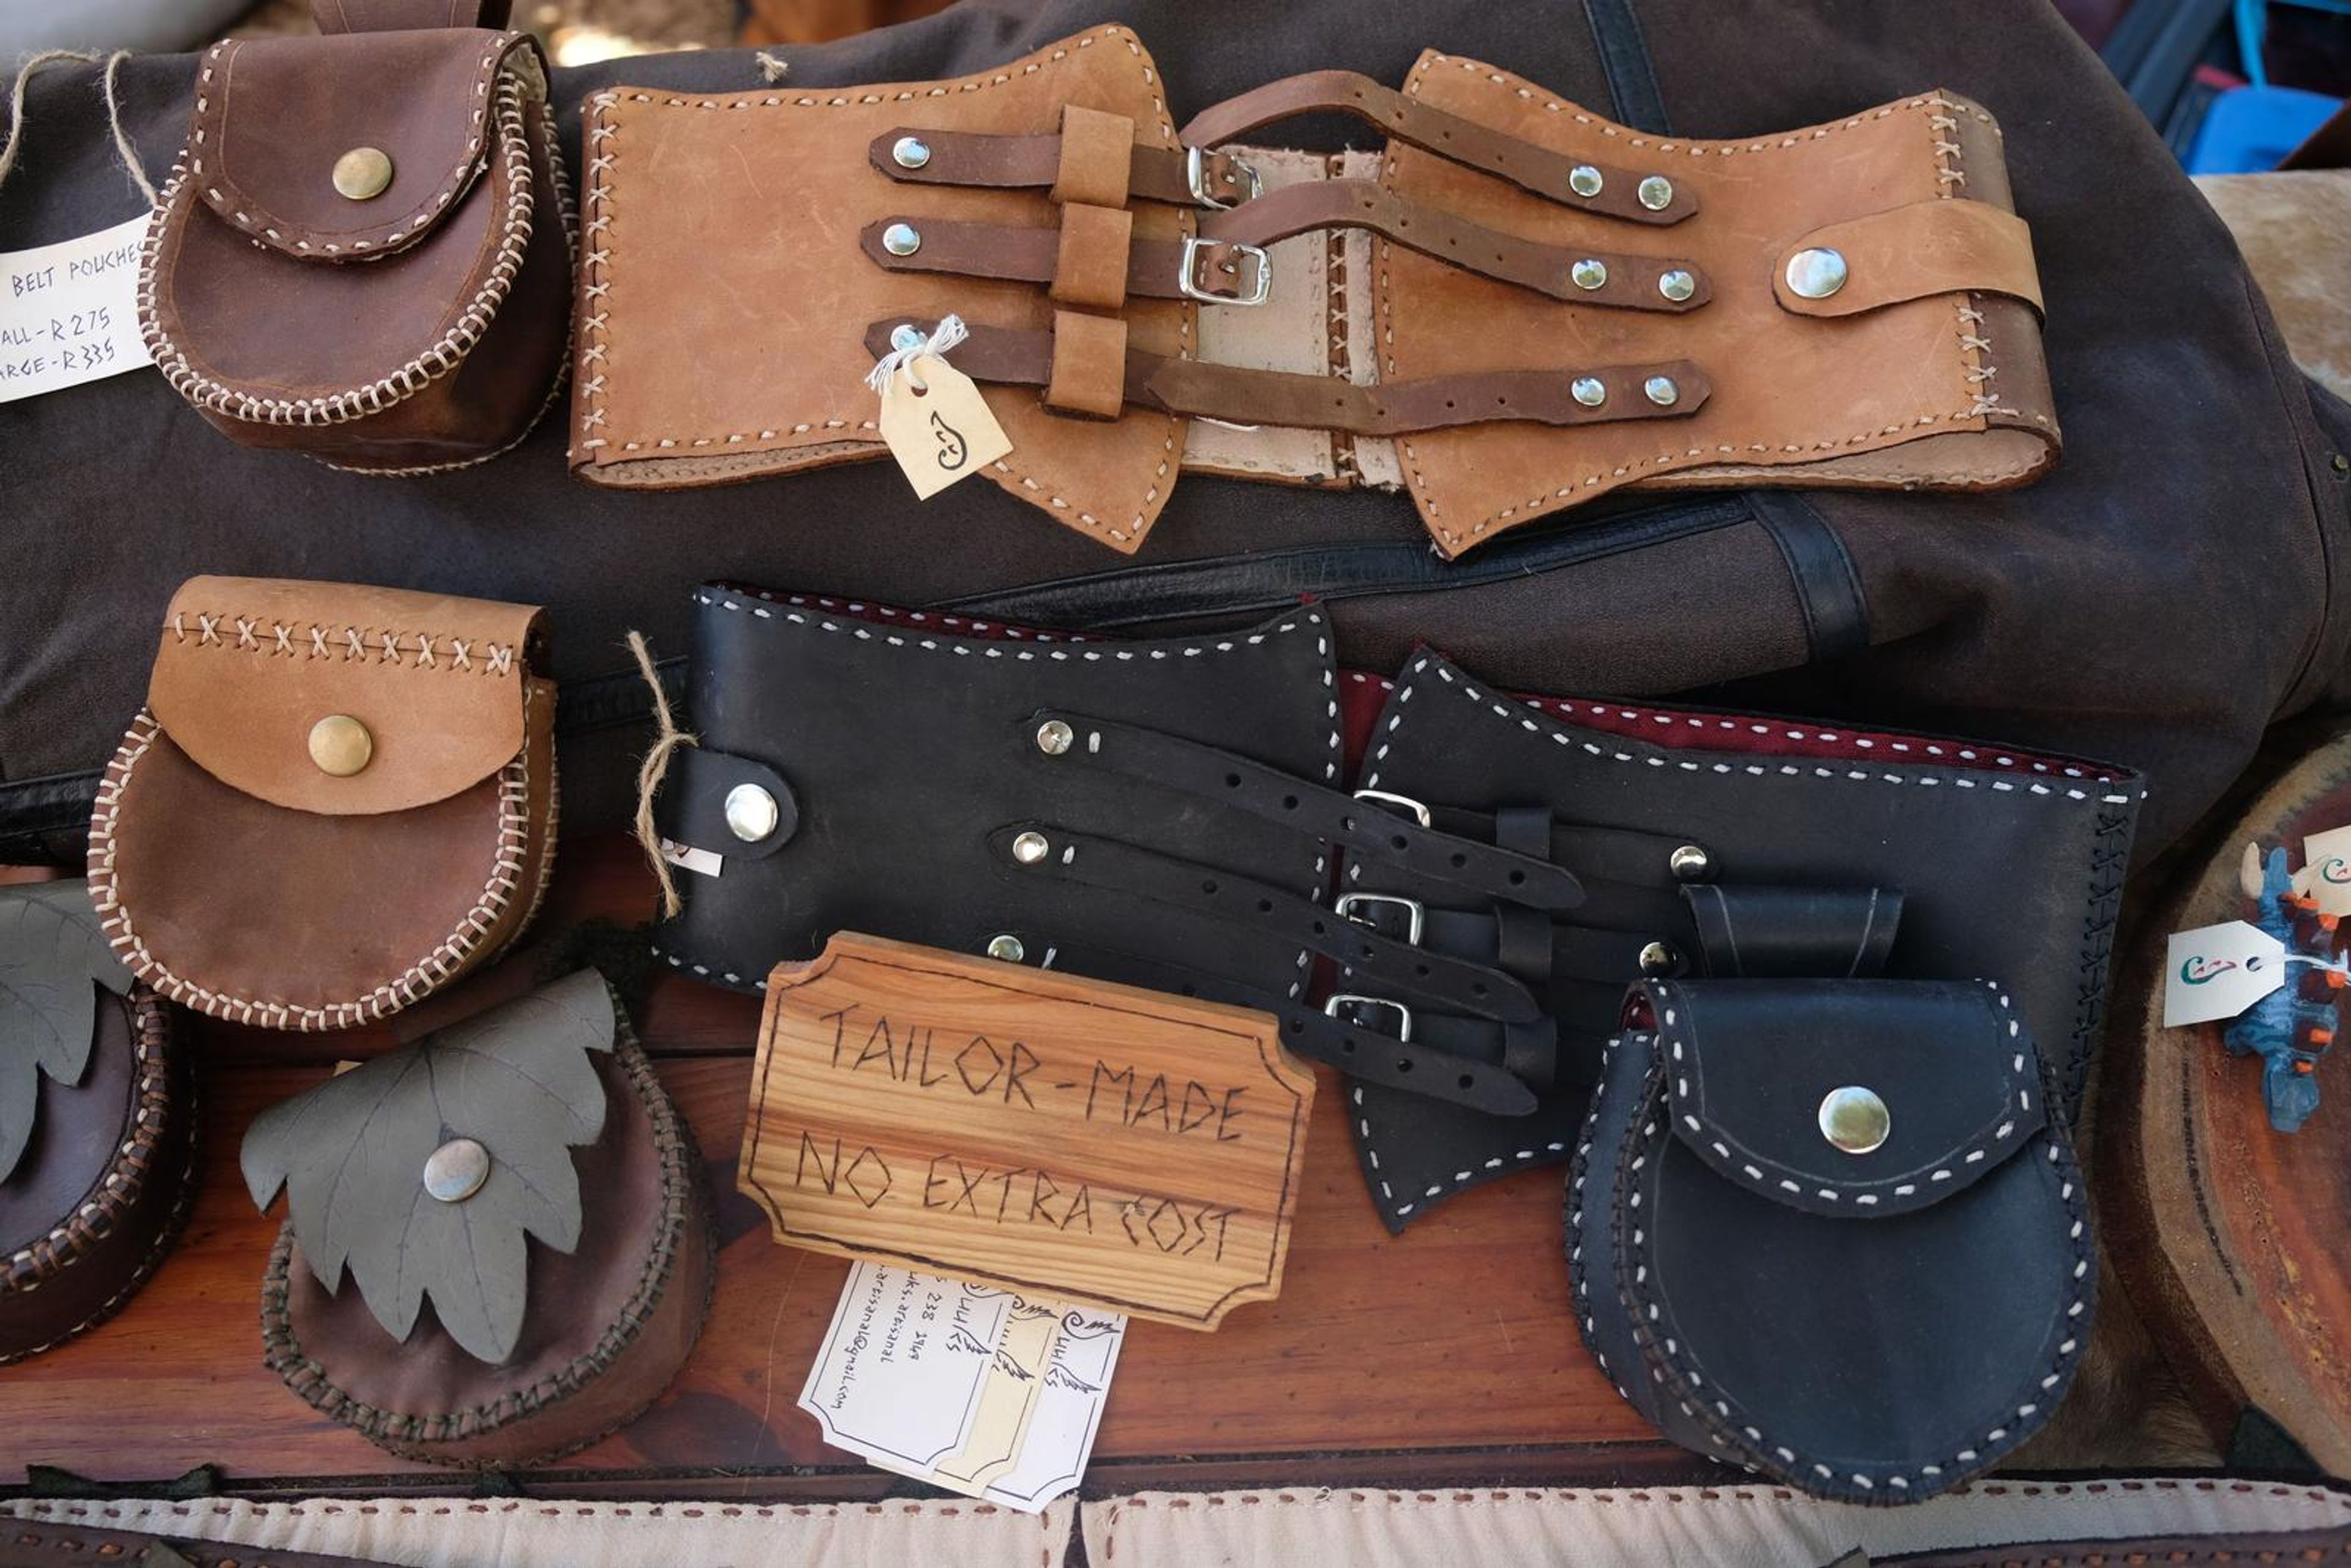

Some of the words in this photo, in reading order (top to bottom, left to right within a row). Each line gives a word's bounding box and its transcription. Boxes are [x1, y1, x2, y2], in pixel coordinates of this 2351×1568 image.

[12, 266, 54, 298] BELT
[819, 1003, 1249, 1141] TAILOR-MADE
[796, 1130, 893, 1209] NO
[923, 1153, 1093, 1235] EXTRA
[1122, 1195, 1243, 1262] COST
[830, 1264, 888, 1409] .artisanal@gmail.com
[921, 1292, 942, 1321] 238
